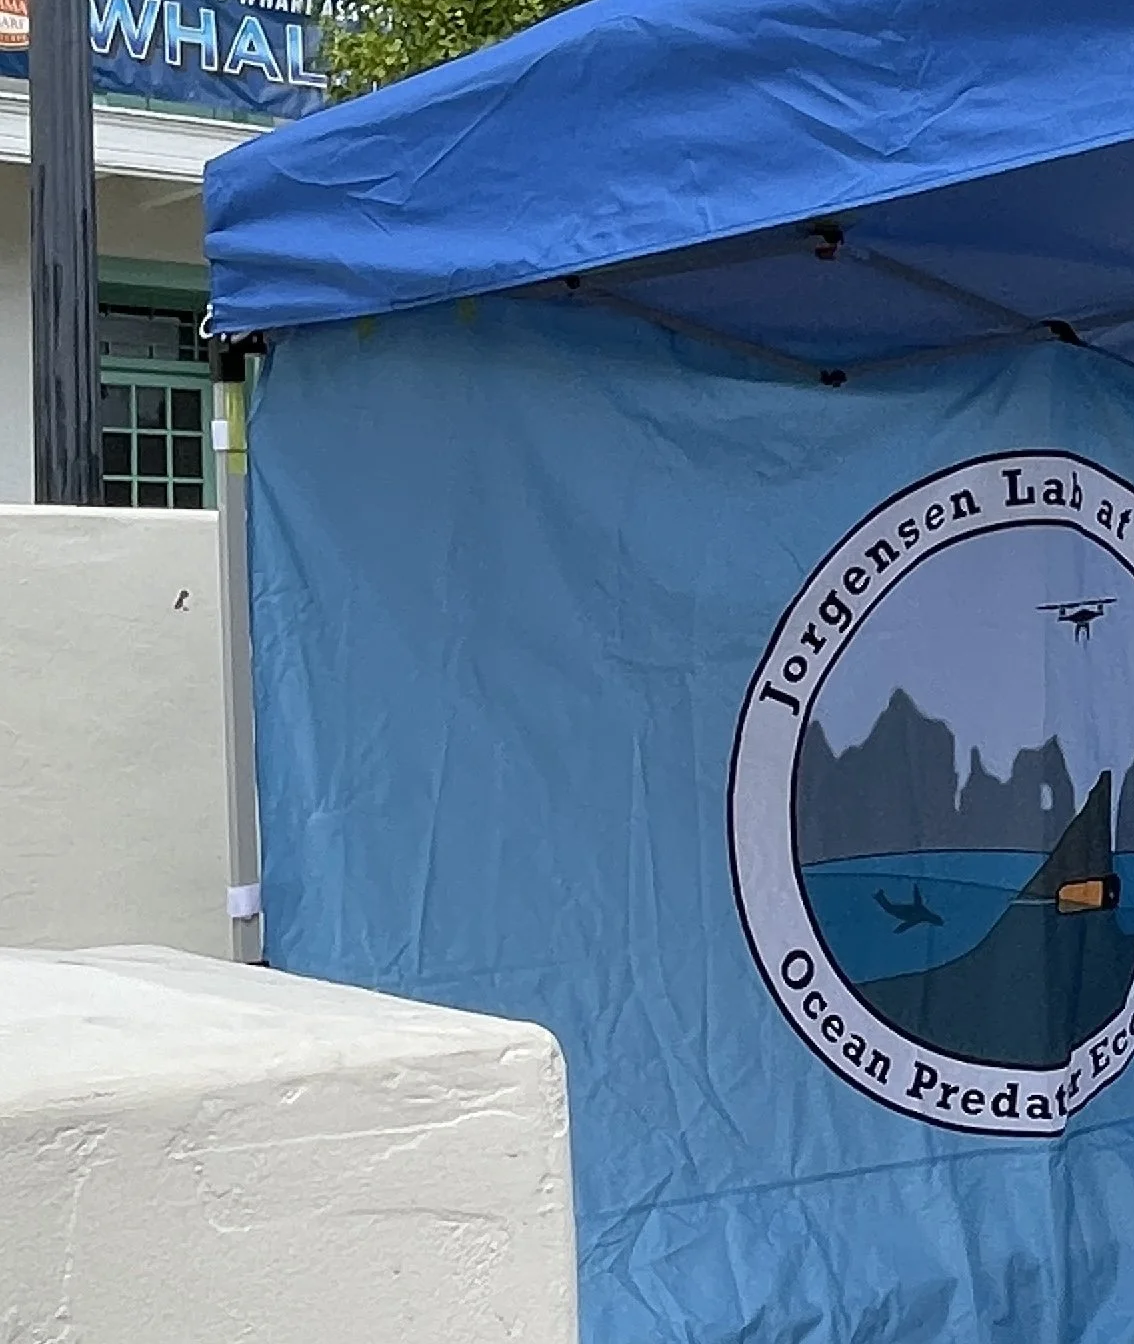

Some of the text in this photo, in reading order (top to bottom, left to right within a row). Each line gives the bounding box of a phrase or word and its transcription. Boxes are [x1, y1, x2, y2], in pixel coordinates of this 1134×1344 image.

[760, 487, 982, 717] Jorgensen
[1002, 468, 1084, 510] Lab
[1096, 499, 1134, 540] at
[781, 948, 891, 1086] Ocean
[906, 1060, 1082, 1120] Predatr
